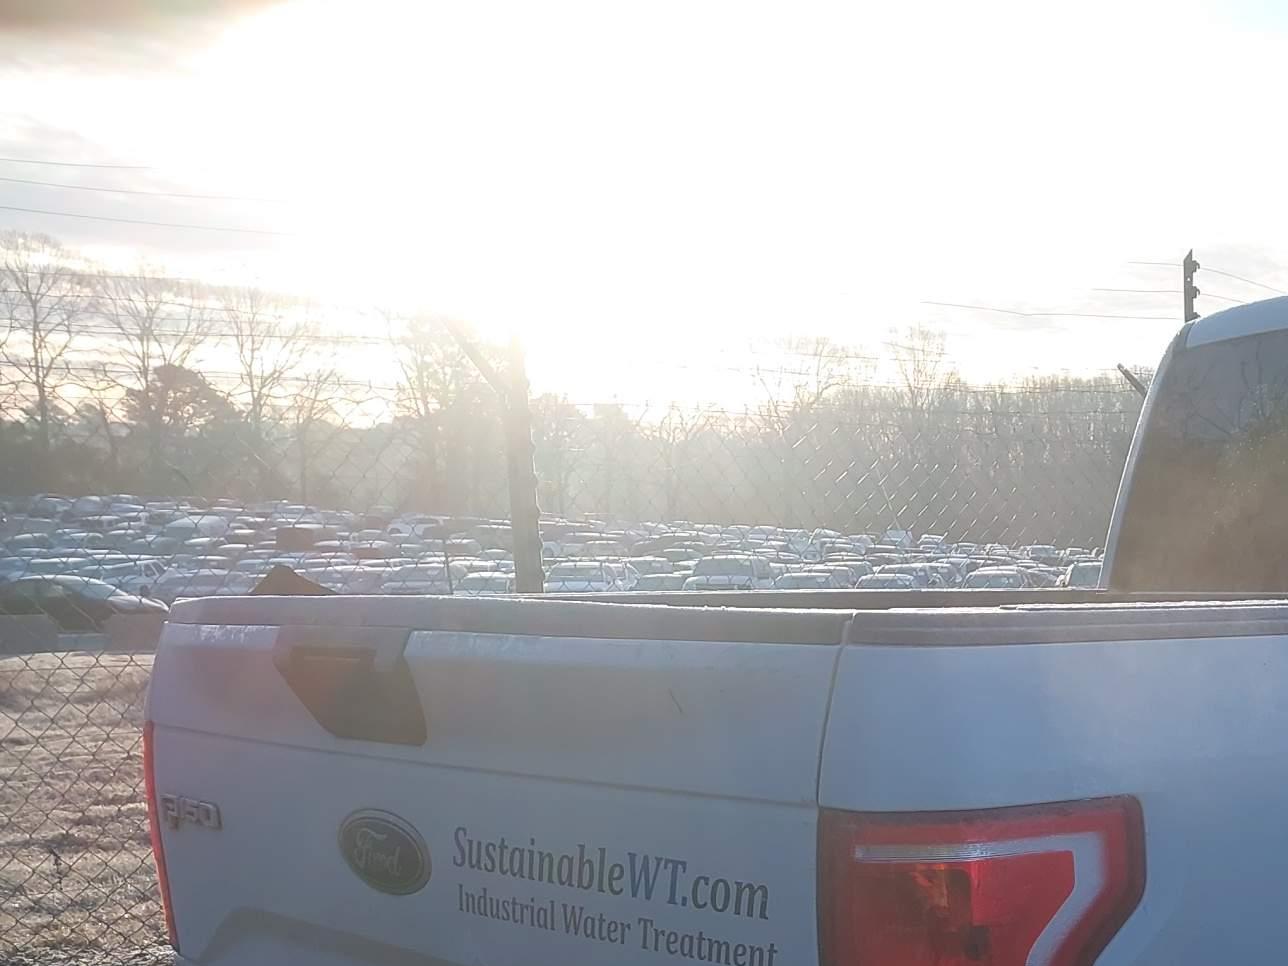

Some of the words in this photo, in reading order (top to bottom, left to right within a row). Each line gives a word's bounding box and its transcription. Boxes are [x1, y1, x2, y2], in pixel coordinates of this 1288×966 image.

[452, 826, 769, 920] SustainableWT.com
[458, 884, 556, 931] Industrial
[561, 903, 631, 945] Water
